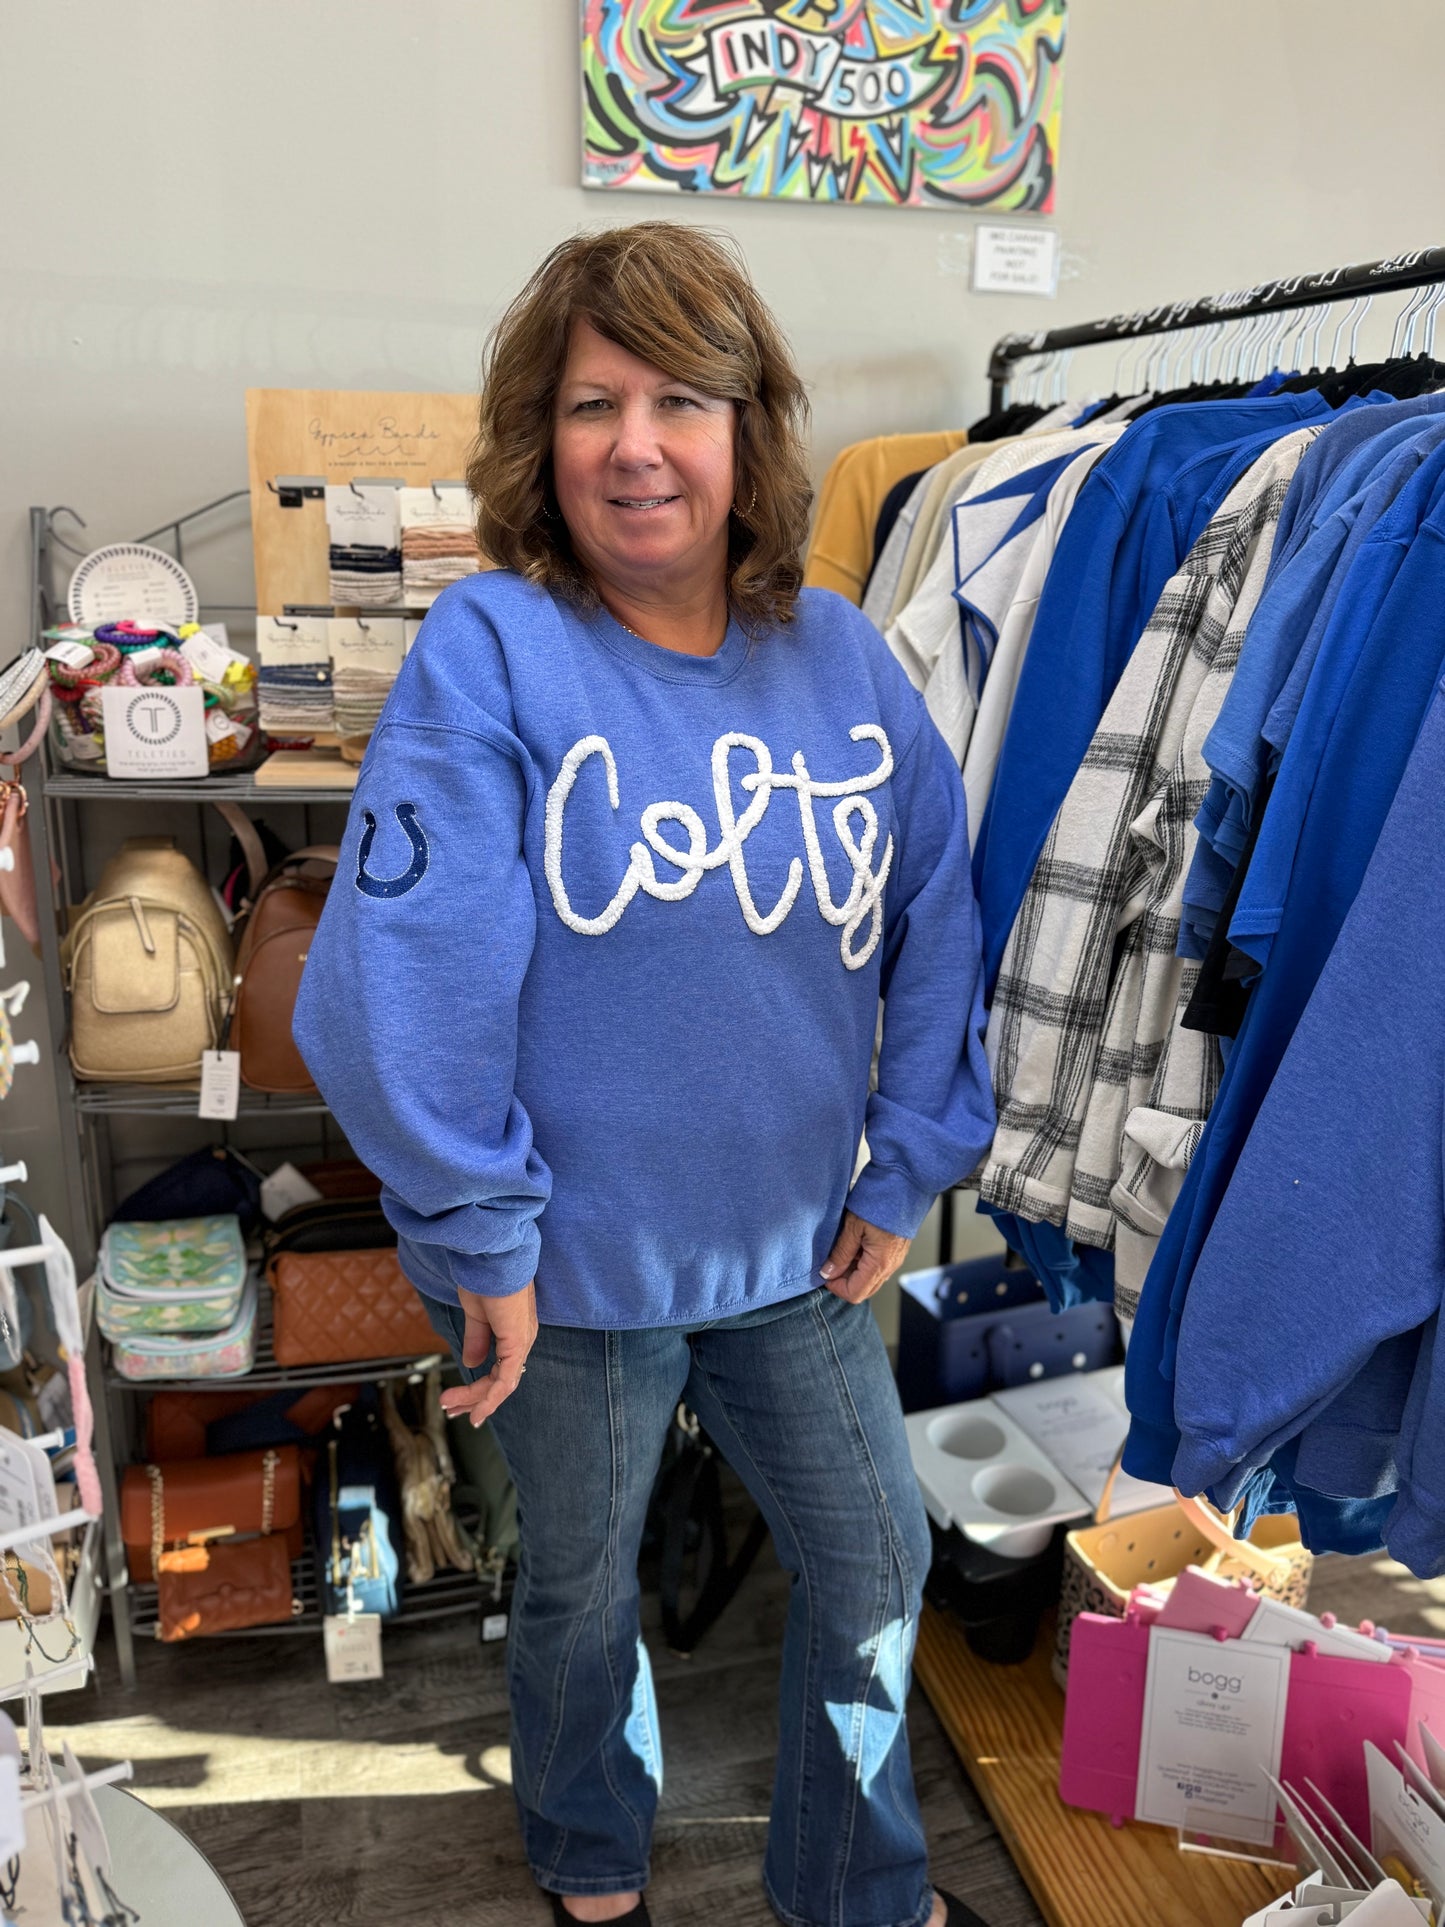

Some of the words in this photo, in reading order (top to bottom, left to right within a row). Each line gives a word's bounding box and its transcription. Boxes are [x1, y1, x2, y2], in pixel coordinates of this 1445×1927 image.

[720, 27, 832, 84] INDY
[832, 63, 911, 109] 500
[128, 750, 187, 759] TELETIES
[544, 723, 895, 971] Colts
[1188, 1665, 1242, 1693] bogg
